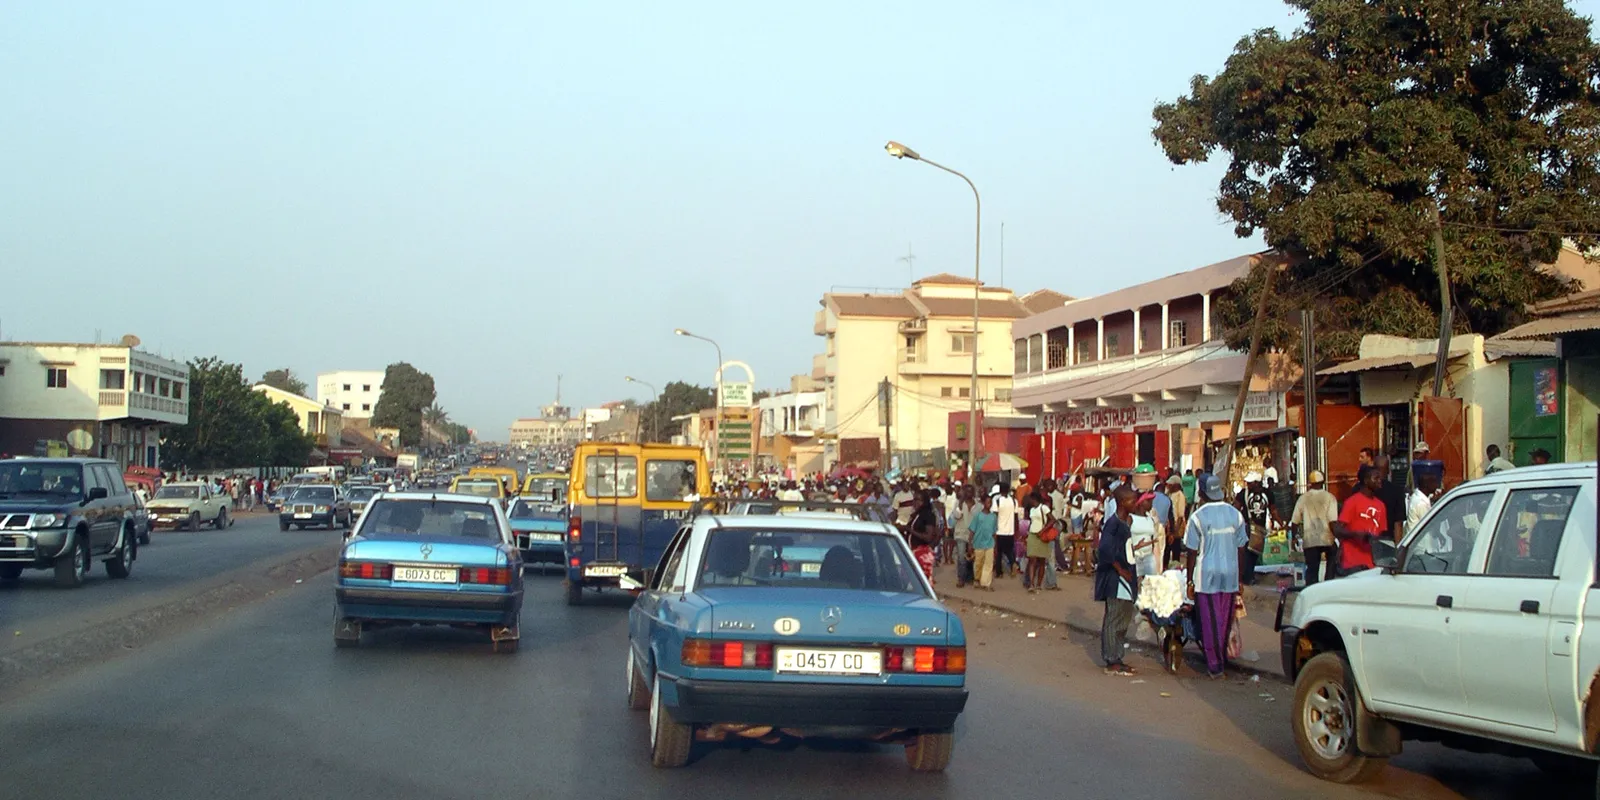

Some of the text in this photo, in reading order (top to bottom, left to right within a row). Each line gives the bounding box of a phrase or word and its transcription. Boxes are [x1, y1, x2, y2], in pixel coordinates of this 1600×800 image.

[405, 569, 446, 581] 6073 CC
[796, 652, 836, 669] 0457
